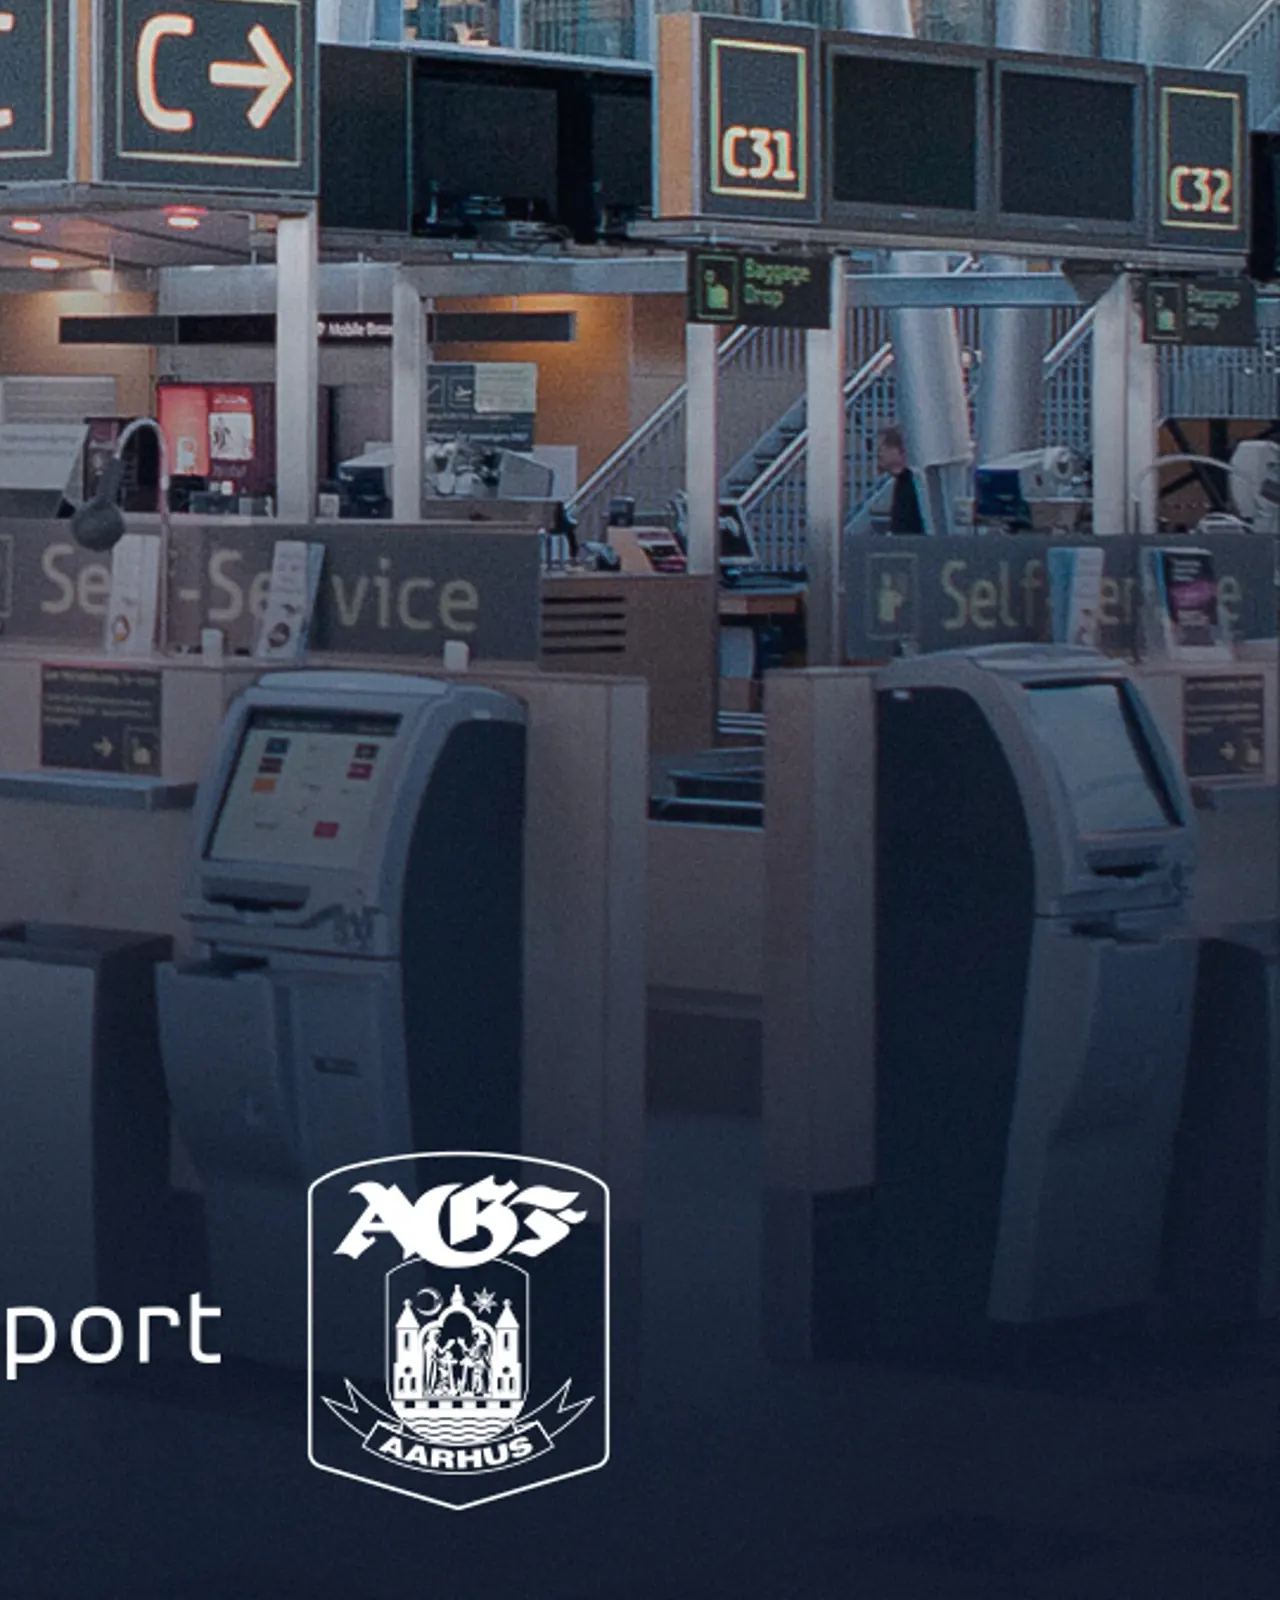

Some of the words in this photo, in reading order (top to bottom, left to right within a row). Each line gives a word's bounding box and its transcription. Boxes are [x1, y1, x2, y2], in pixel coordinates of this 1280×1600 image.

[135, 13, 194, 132] C
[722, 125, 797, 181] C31
[1169, 166, 1233, 214] C32
